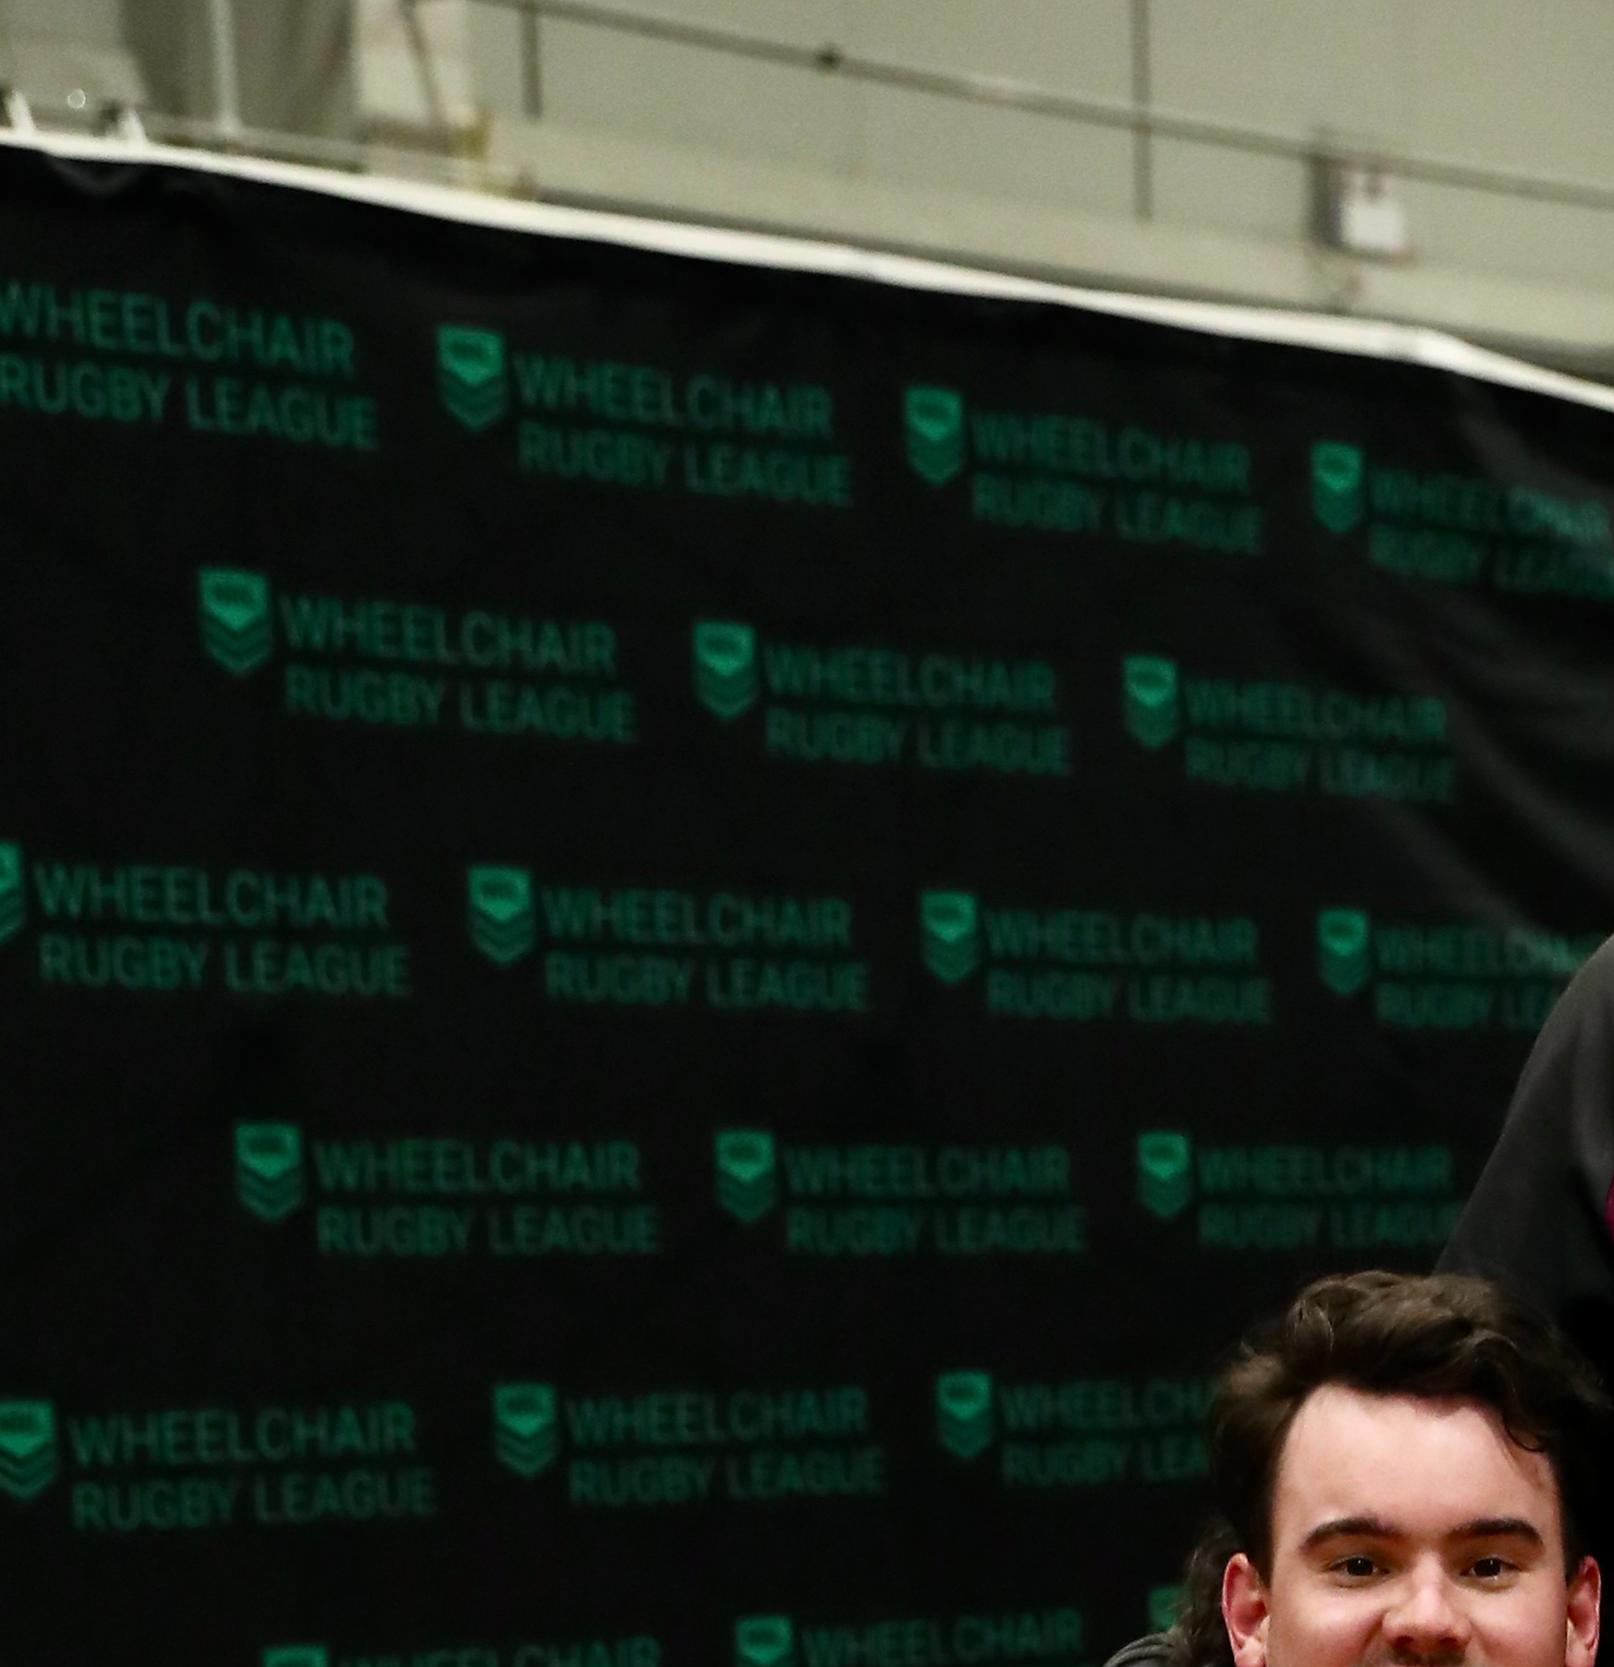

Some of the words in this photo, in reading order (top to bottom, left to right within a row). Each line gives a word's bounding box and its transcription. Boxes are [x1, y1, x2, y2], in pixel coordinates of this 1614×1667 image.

[186, 372, 379, 452] LEAGUE
[515, 351, 835, 439] WHEELCHAIR
[519, 421, 668, 488] RUGBY
[686, 439, 853, 507] LEAGUE
[970, 412, 1252, 494] WHEELCHAIR
[1116, 491, 1263, 555] LEAGUE
[283, 596, 617, 675] WHEELCHAIR
[287, 665, 447, 726] RUGBY
[461, 687, 637, 744] LEAGUE
[765, 644, 1056, 710] WHEELCHAIR
[766, 708, 908, 761] RUGBY
[917, 722, 1072, 777] LEAGUE
[1319, 749, 1452, 797] LEAGUE
[33, 862, 390, 931] WHEELCHAIR
[541, 887, 853, 948] WHEELCHAIR
[40, 933, 209, 989] RUGBY
[225, 941, 410, 997] LEAGUE
[985, 908, 1258, 966] WHEELCHAIR
[545, 951, 693, 1004] RUGBY
[707, 958, 870, 1011] LEAGUE
[987, 968, 1117, 1021] RUGBY
[1129, 975, 1272, 1026] LEAGUE
[1376, 981, 1493, 1031] RUGBY
[312, 1139, 642, 1195] WHEELCHAIR
[783, 1145, 1073, 1197] WHEELCHAIR
[1200, 1144, 1453, 1196] WHEELCHAIR
[316, 1208, 473, 1256] RUGBY
[487, 1205, 660, 1255] LEAGUE
[785, 1208, 923, 1255] RUGBY
[936, 1205, 1089, 1254] LEAGUE
[1200, 1199, 1319, 1249] RUGBY
[566, 1385, 870, 1447] WHEELCHAIR
[1003, 1376, 1206, 1429] WHEELCH
[67, 1401, 417, 1467] WHEELCHAIR
[1003, 1440, 1128, 1488] RUGBY
[1141, 1433, 1211, 1481] LEA
[71, 1477, 239, 1532] RUGBY
[253, 1466, 438, 1524] LEAGUE
[569, 1455, 711, 1506] RUGBY
[725, 1443, 887, 1498] LEAGUE
